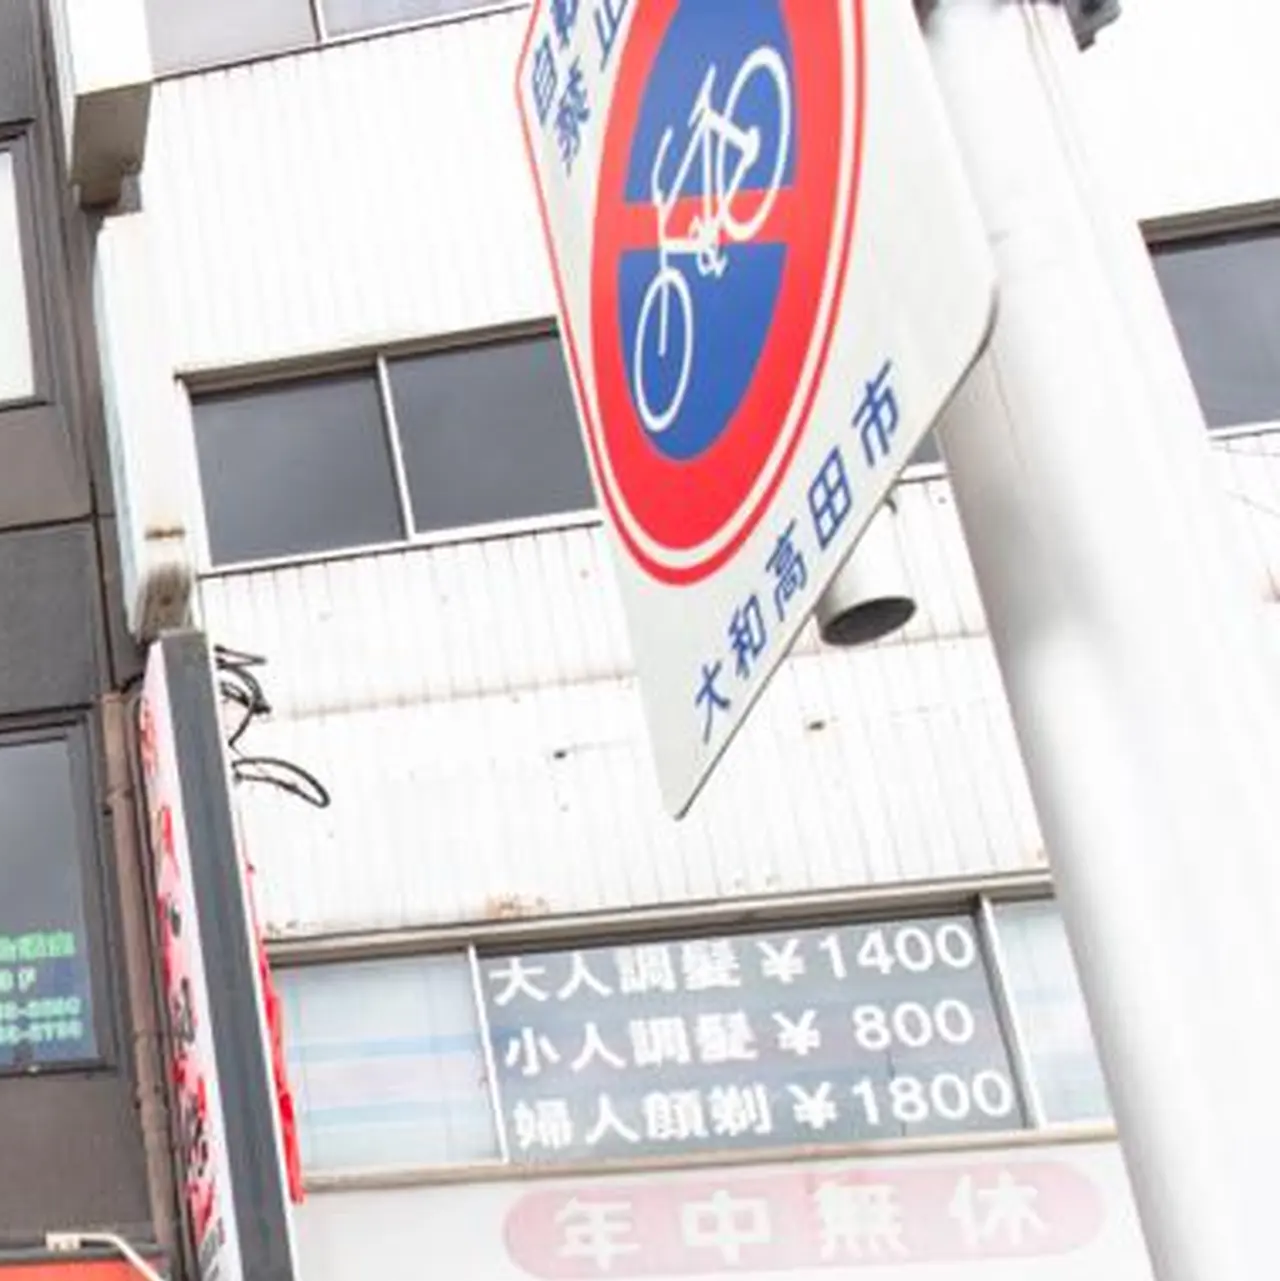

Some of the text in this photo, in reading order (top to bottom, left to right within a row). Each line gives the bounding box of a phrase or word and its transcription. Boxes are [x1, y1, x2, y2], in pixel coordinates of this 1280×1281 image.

[692, 360, 900, 743] 大和高田市
[555, 1172, 1048, 1270] 年中無休
